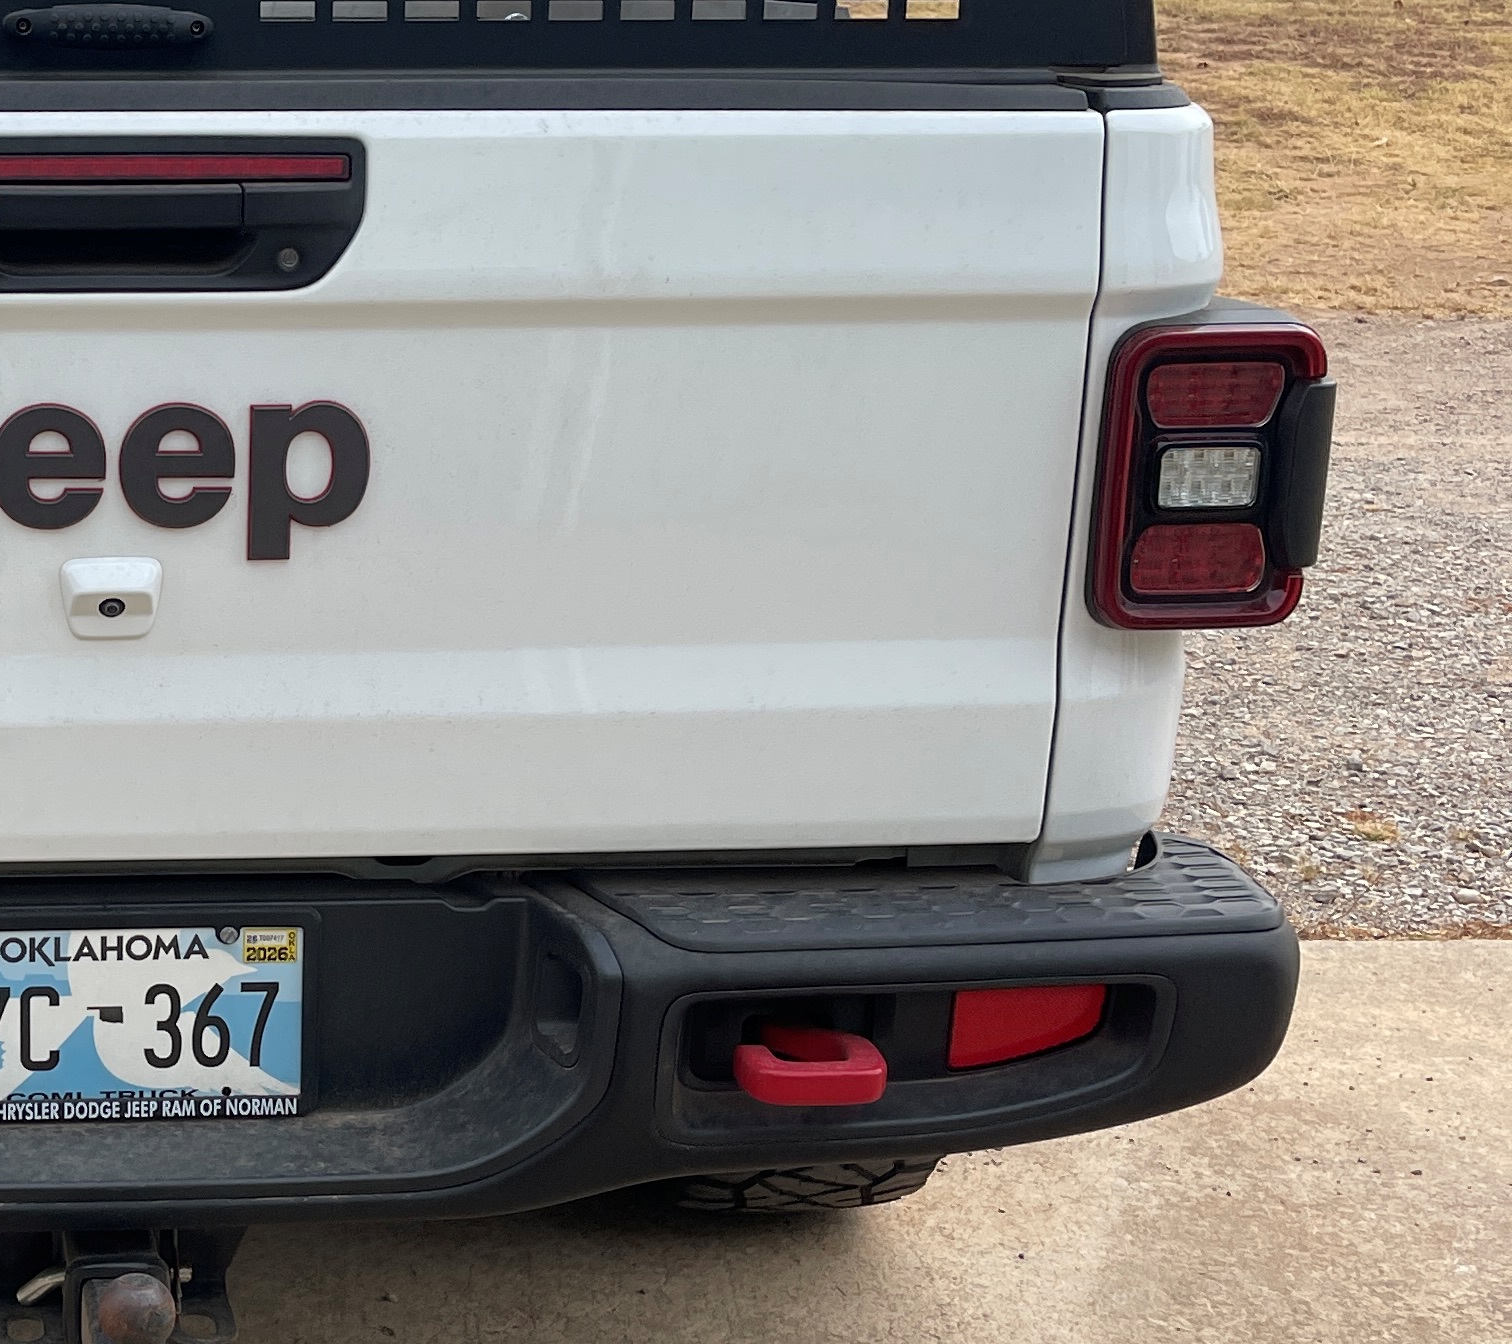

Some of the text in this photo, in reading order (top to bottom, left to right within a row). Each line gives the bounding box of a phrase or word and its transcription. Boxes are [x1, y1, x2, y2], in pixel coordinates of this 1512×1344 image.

[0, 934, 209, 967] OKLAHOMA
[246, 946, 288, 961] 2026
[63, 1100, 120, 1120] DODGE
[124, 1100, 158, 1119] JEEP
[162, 1099, 196, 1117] RAM
[200, 1099, 222, 1117] OF
[226, 1097, 297, 1116] NORMAN
